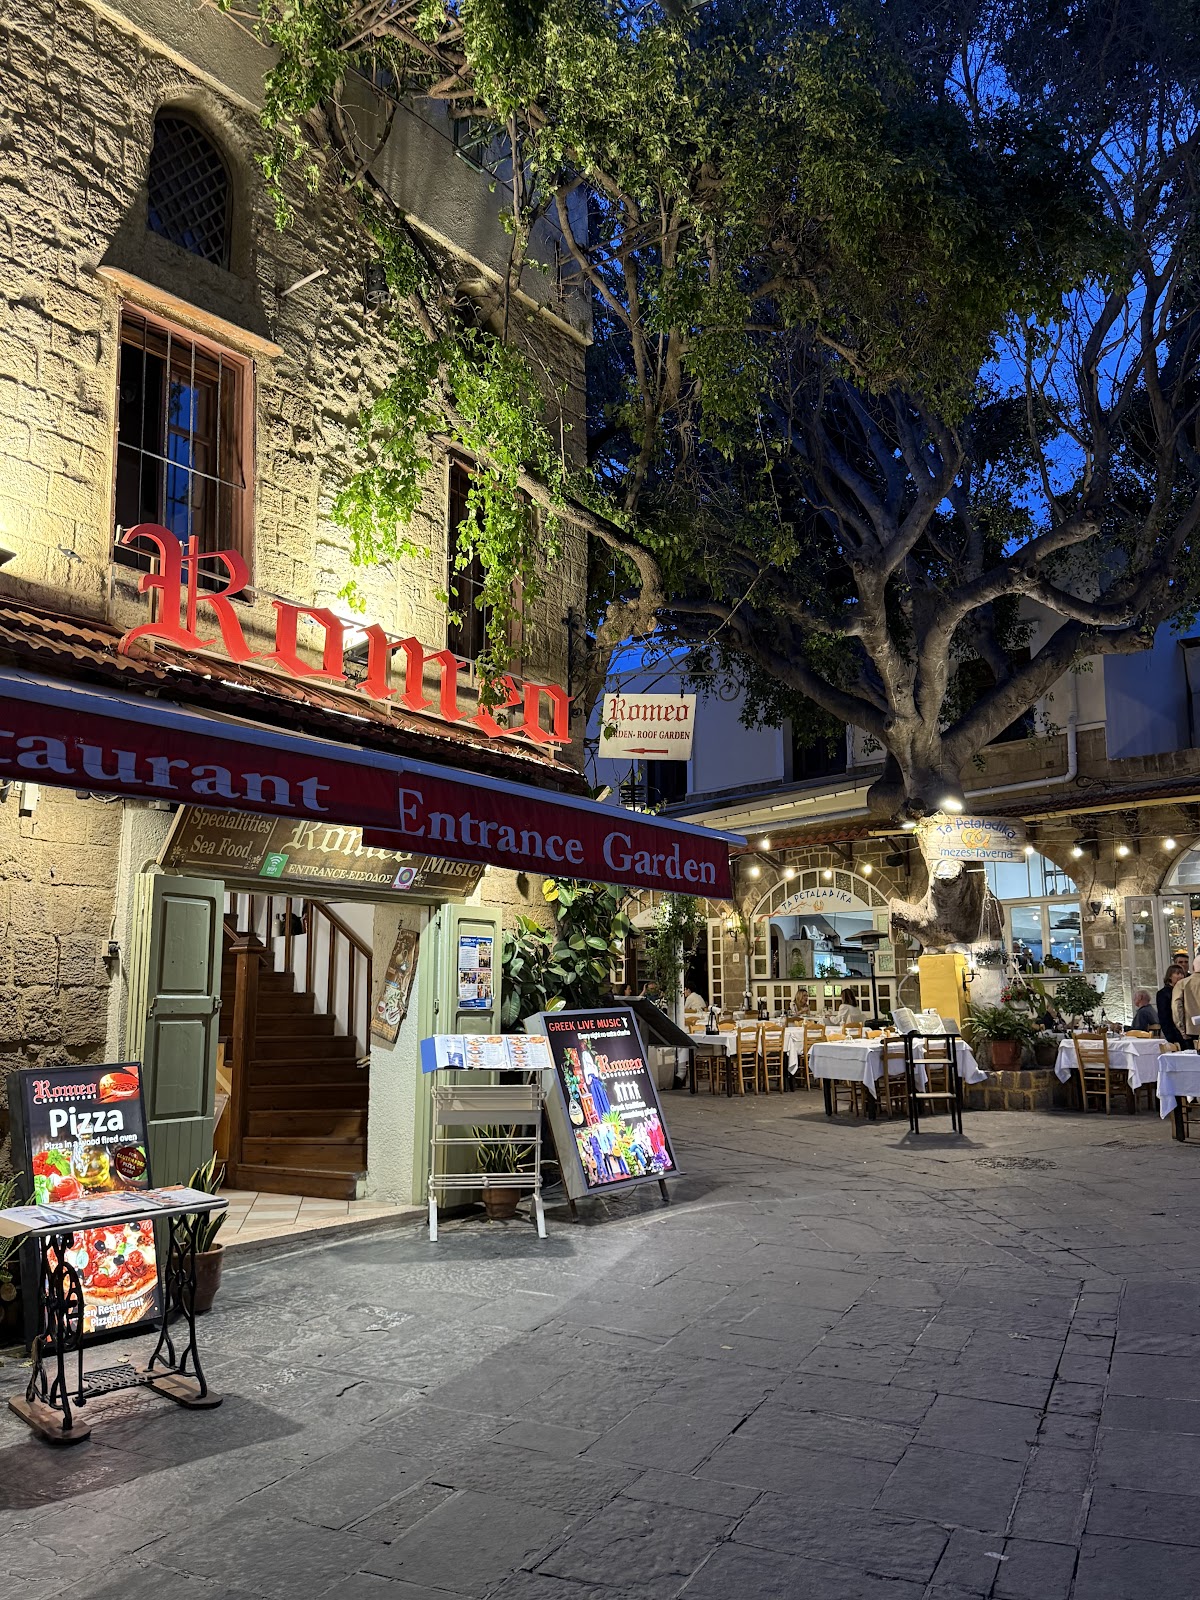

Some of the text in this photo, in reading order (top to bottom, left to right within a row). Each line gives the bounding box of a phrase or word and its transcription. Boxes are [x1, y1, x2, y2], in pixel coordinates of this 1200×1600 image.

[118, 523, 575, 744] Romeo
[608, 699, 690, 722] Romeo
[637, 730, 657, 739] ROOF
[659, 730, 691, 740] GARDEN
[399, 788, 584, 865] Entrance
[603, 831, 716, 886] Garden
[936, 817, 1016, 840] Ta Petaladika
[190, 834, 253, 859] Sea Food
[940, 848, 1013, 859] mezes-Taverna
[424, 857, 480, 878] Music
[781, 900, 792, 910] TA
[548, 1018, 622, 1032] GREEK LIVE MUSIC
[32, 1079, 97, 1099] Romeo
[49, 1106, 124, 1138] Pizza
[44, 1141, 63, 1151] Pizza
[64, 1139, 72, 1149] in
[79, 1136, 101, 1146] wood
[101, 1134, 119, 1145] fired
[119, 1133, 138, 1143] oven
[98, 1297, 144, 1316] Restaurant
[90, 1313, 123, 1327] Pizzeria
